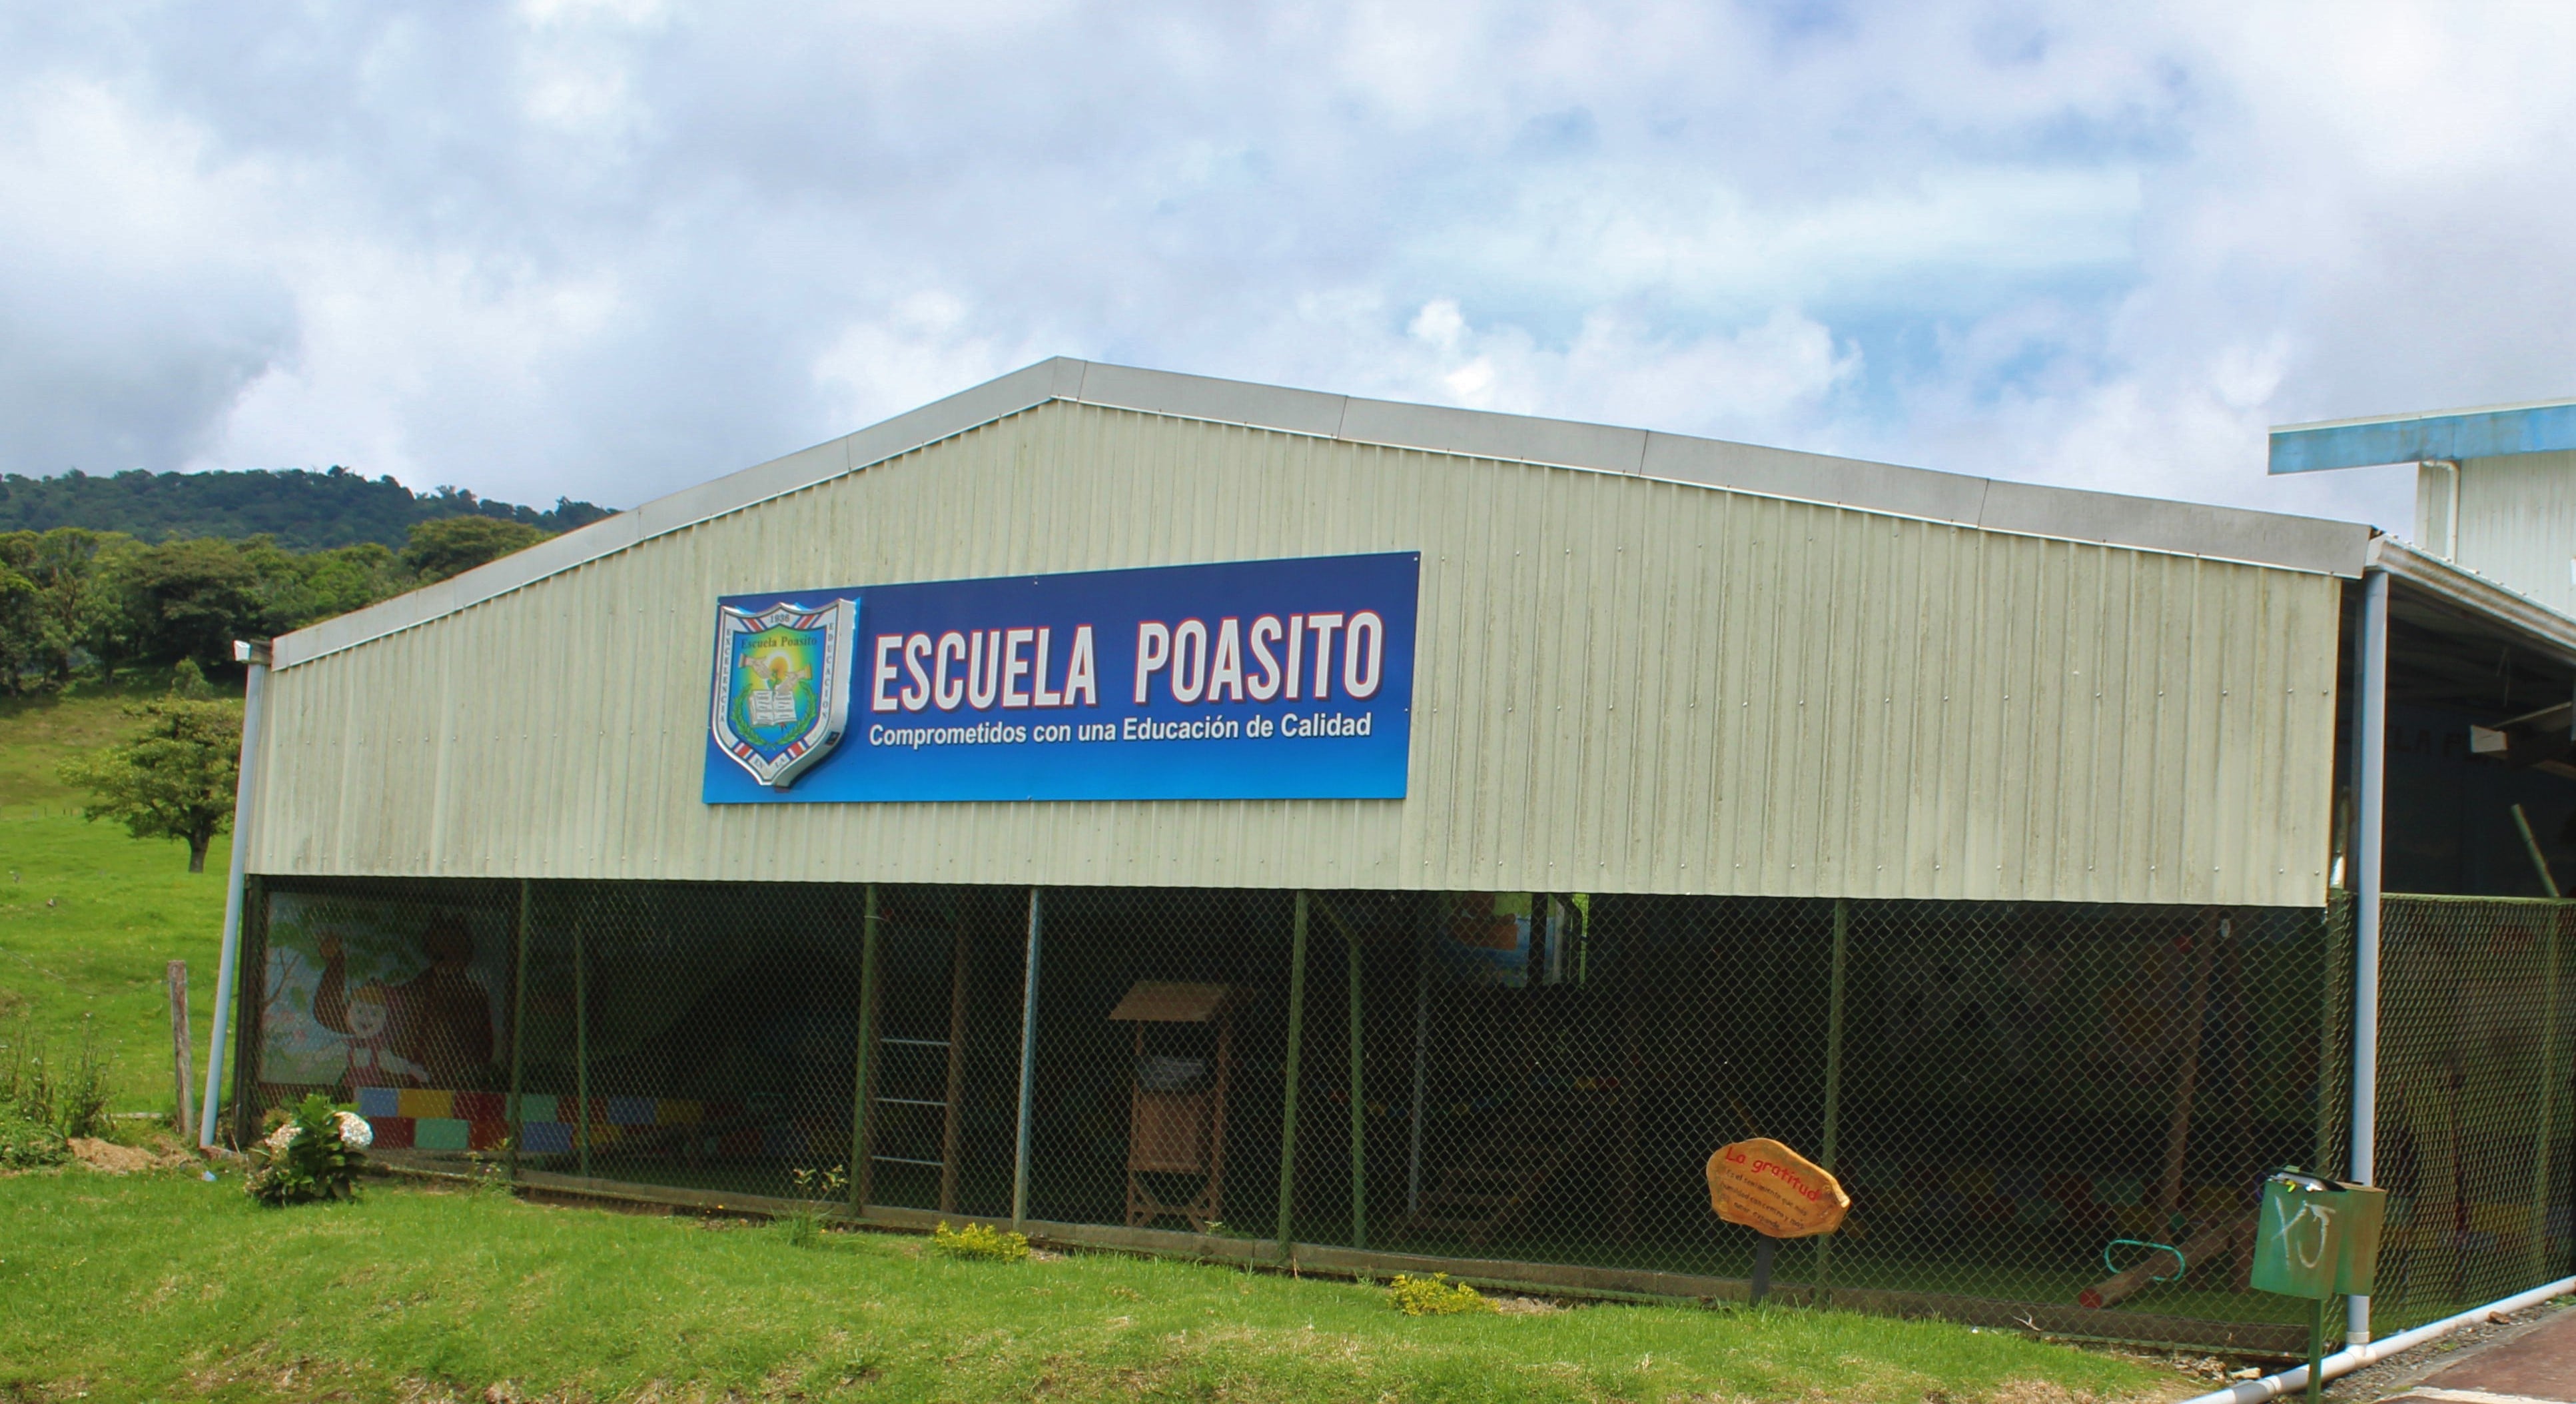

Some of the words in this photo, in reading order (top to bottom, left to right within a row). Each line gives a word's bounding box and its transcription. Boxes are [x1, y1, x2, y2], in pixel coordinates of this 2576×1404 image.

[740, 637, 777, 650] Escuela
[781, 635, 817, 647] Poasito
[871, 623, 1099, 713] ESCUELA
[1134, 609, 1386, 705] POASITO
[869, 721, 1027, 750] Comprometidos
[1033, 724, 1071, 743] con
[1078, 723, 1116, 742] una
[1122, 714, 1239, 741] Educación
[1246, 714, 1274, 738] de
[1281, 712, 1372, 738] Calidad
[1725, 1147, 1745, 1165] La
[1751, 1159, 1821, 1202] gratitud
